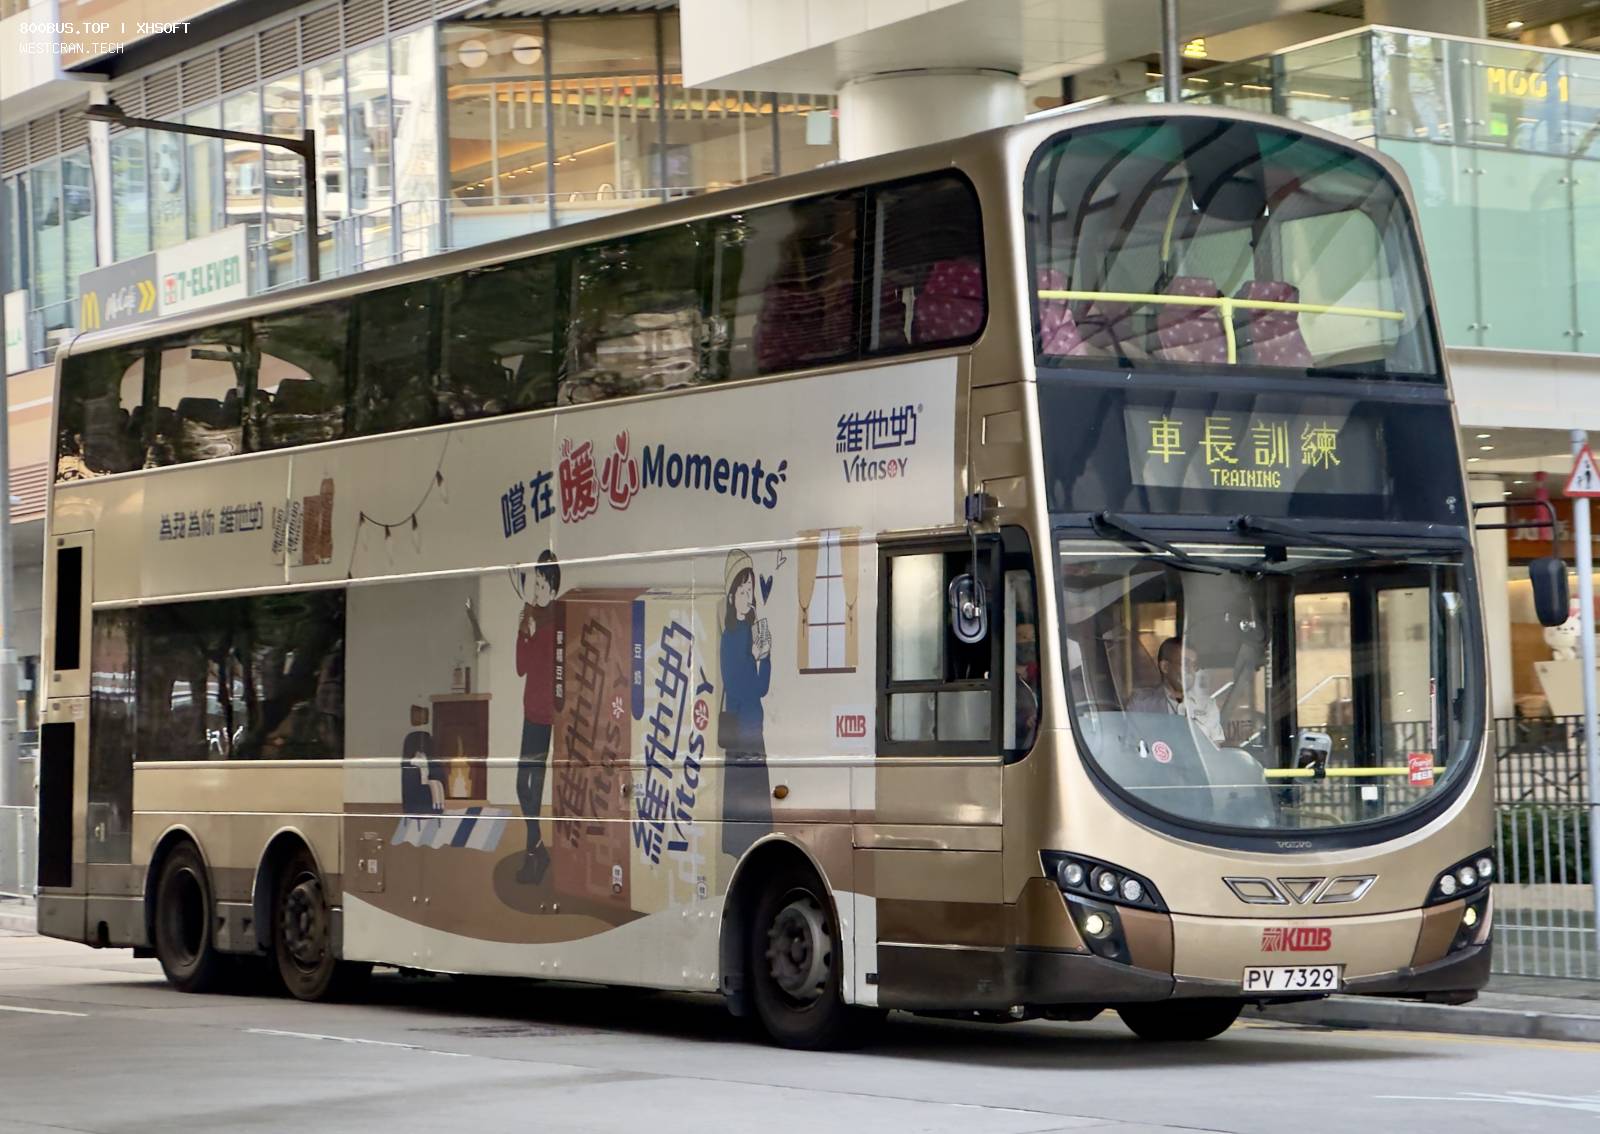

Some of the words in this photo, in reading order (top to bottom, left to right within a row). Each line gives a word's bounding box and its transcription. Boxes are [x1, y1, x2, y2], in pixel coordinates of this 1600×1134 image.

[836, 405, 917, 453] 維他奶
[1147, 414, 1341, 470] 車長訓練
[642, 443, 780, 510] Moments
[1209, 468, 1282, 489] TRAINING
[632, 619, 695, 865] 維他奶
[836, 715, 866, 737] KMB
[1281, 927, 1333, 952] KMB
[1248, 969, 1274, 989] PV
[1284, 968, 1334, 988] 7329
